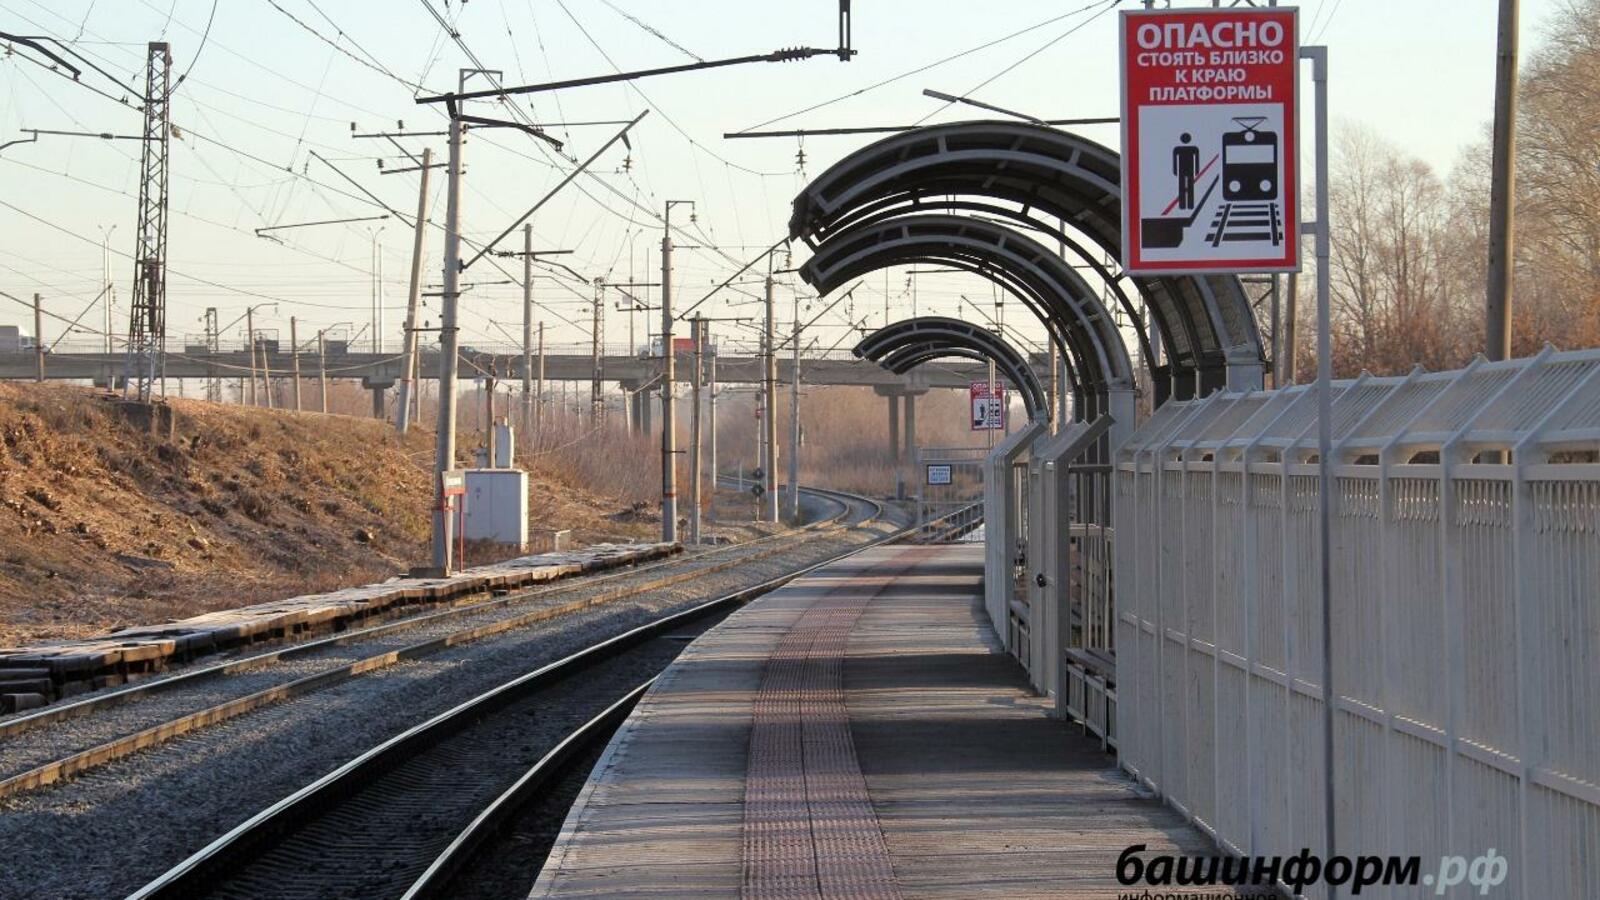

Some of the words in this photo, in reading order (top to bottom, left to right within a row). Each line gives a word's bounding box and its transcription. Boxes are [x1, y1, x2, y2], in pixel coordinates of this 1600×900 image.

[1137, 21, 1284, 49] ОПАСНО
[1137, 52, 1206, 66] СТОЯТЬ
[1210, 50, 1284, 65] БЛИЗКО
[1175, 69, 1188, 83] К
[1192, 68, 1246, 83] КРАЮ
[1150, 85, 1272, 101] ПЛАТФОРМЫ
